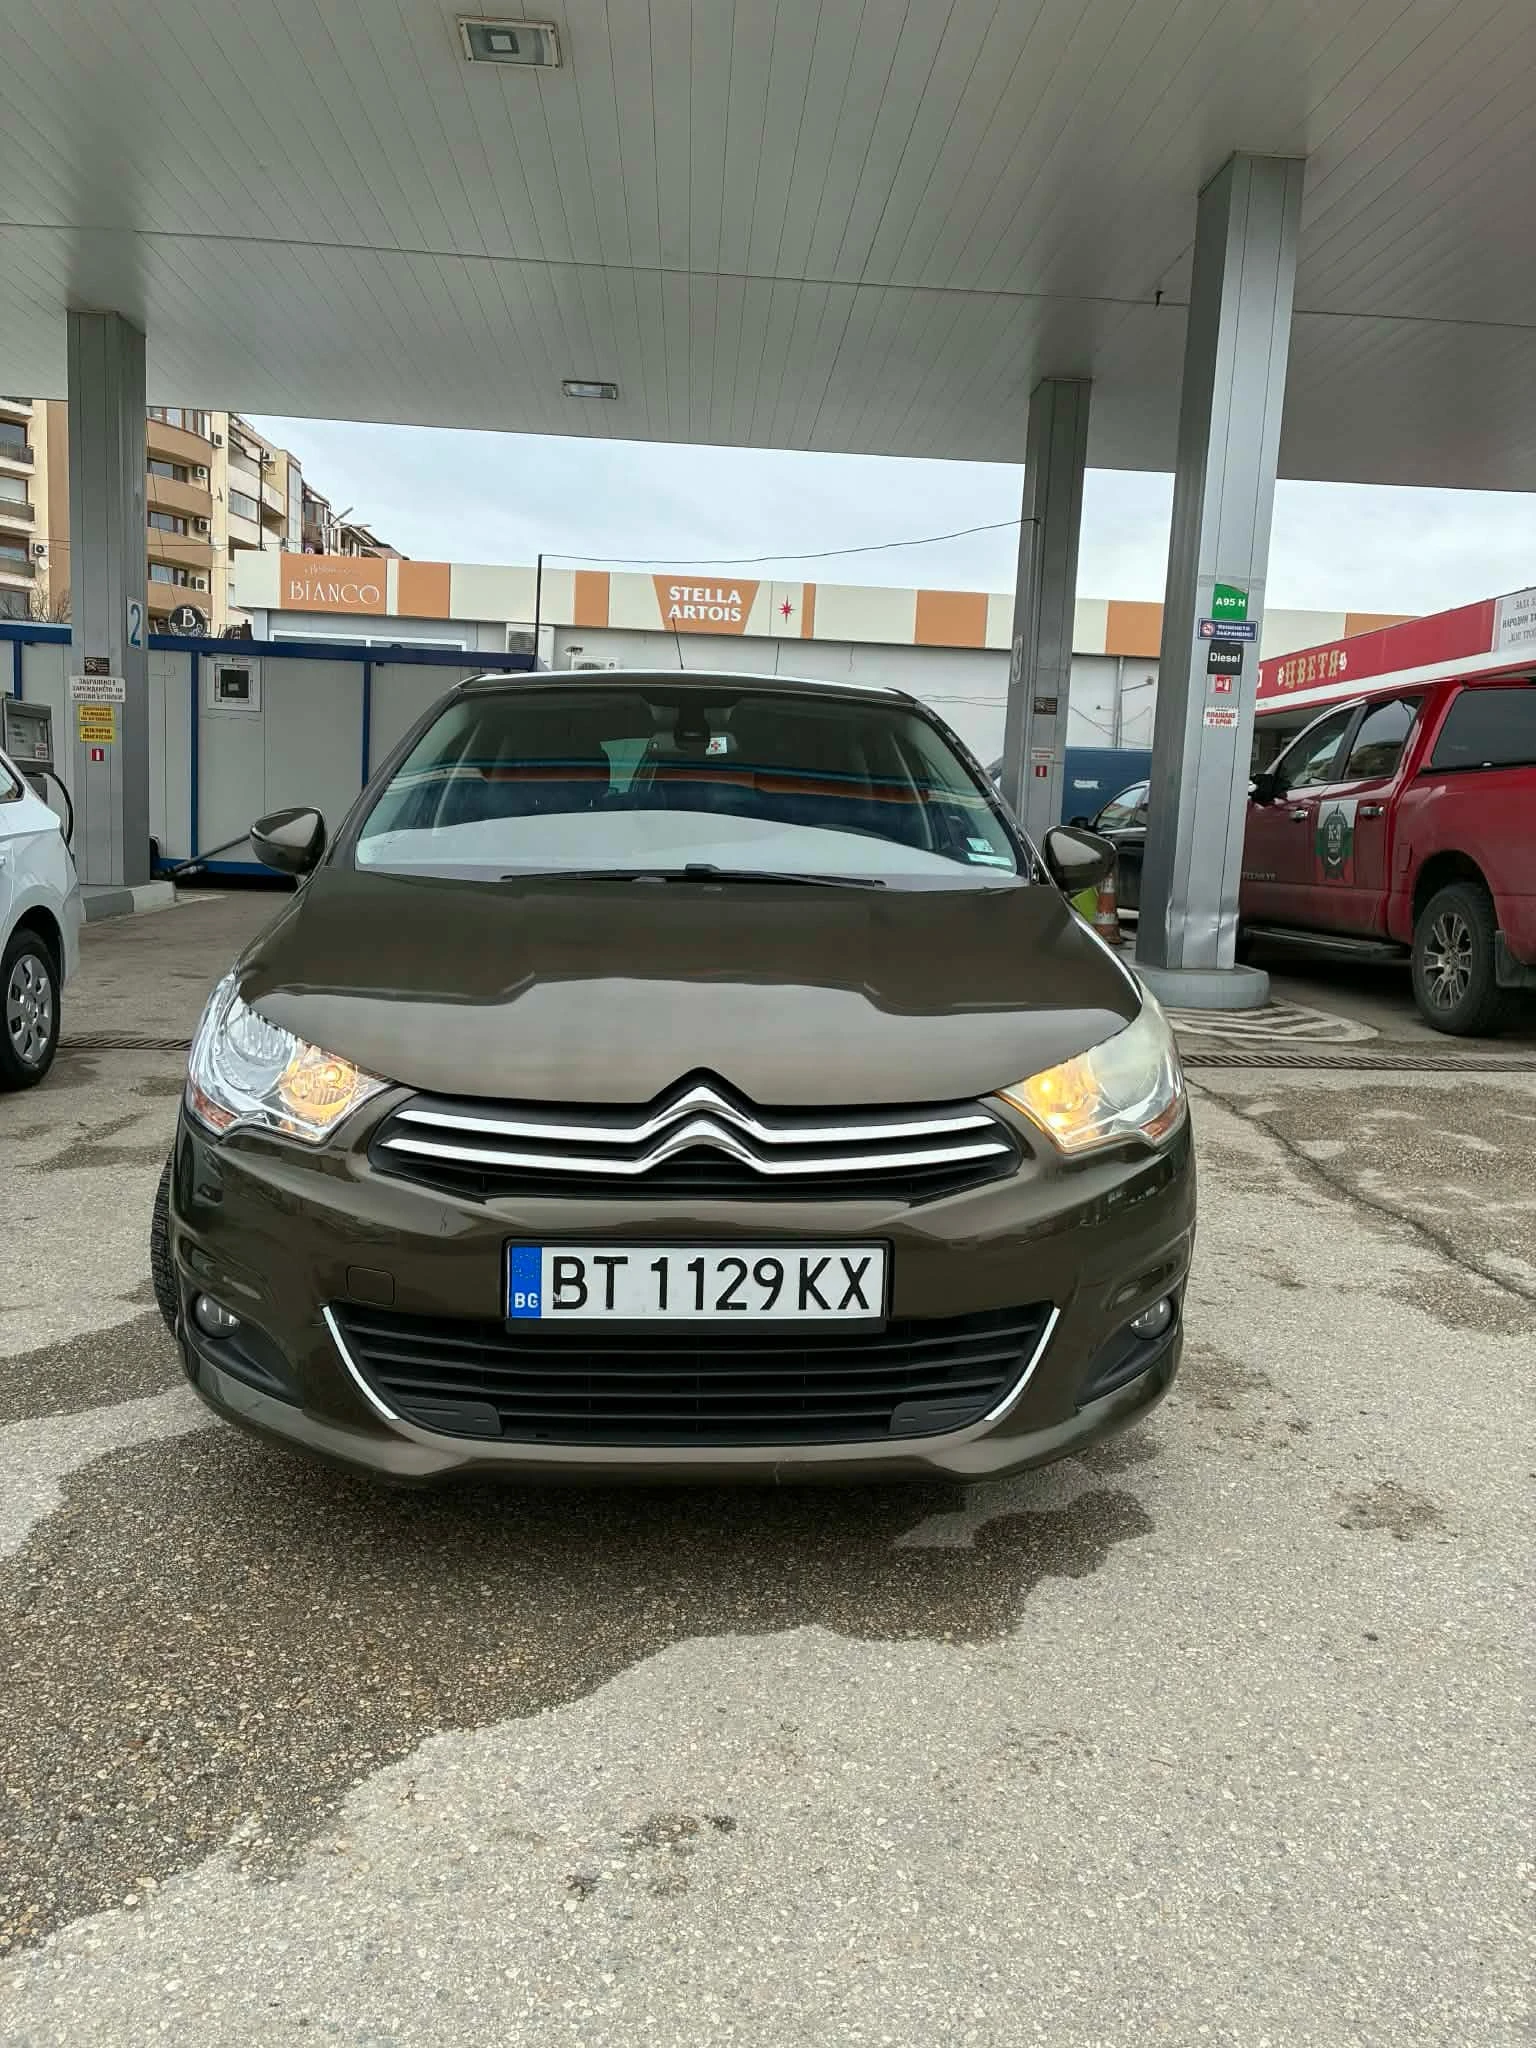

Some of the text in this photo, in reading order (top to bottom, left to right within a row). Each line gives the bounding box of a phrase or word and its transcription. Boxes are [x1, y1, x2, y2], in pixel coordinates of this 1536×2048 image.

[288, 580, 380, 605] BIANCO
[669, 585, 742, 605] STELLA
[1216, 597, 1236, 607] A95
[668, 604, 742, 622] ARTOIS
[131, 603, 141, 646] 2
[1210, 652, 1241, 663] Diesel
[1284, 649, 1340, 689] ЦВЕТЯ
[552, 1256, 872, 1311] BT 1129 KX
[514, 1292, 539, 1309] BG
